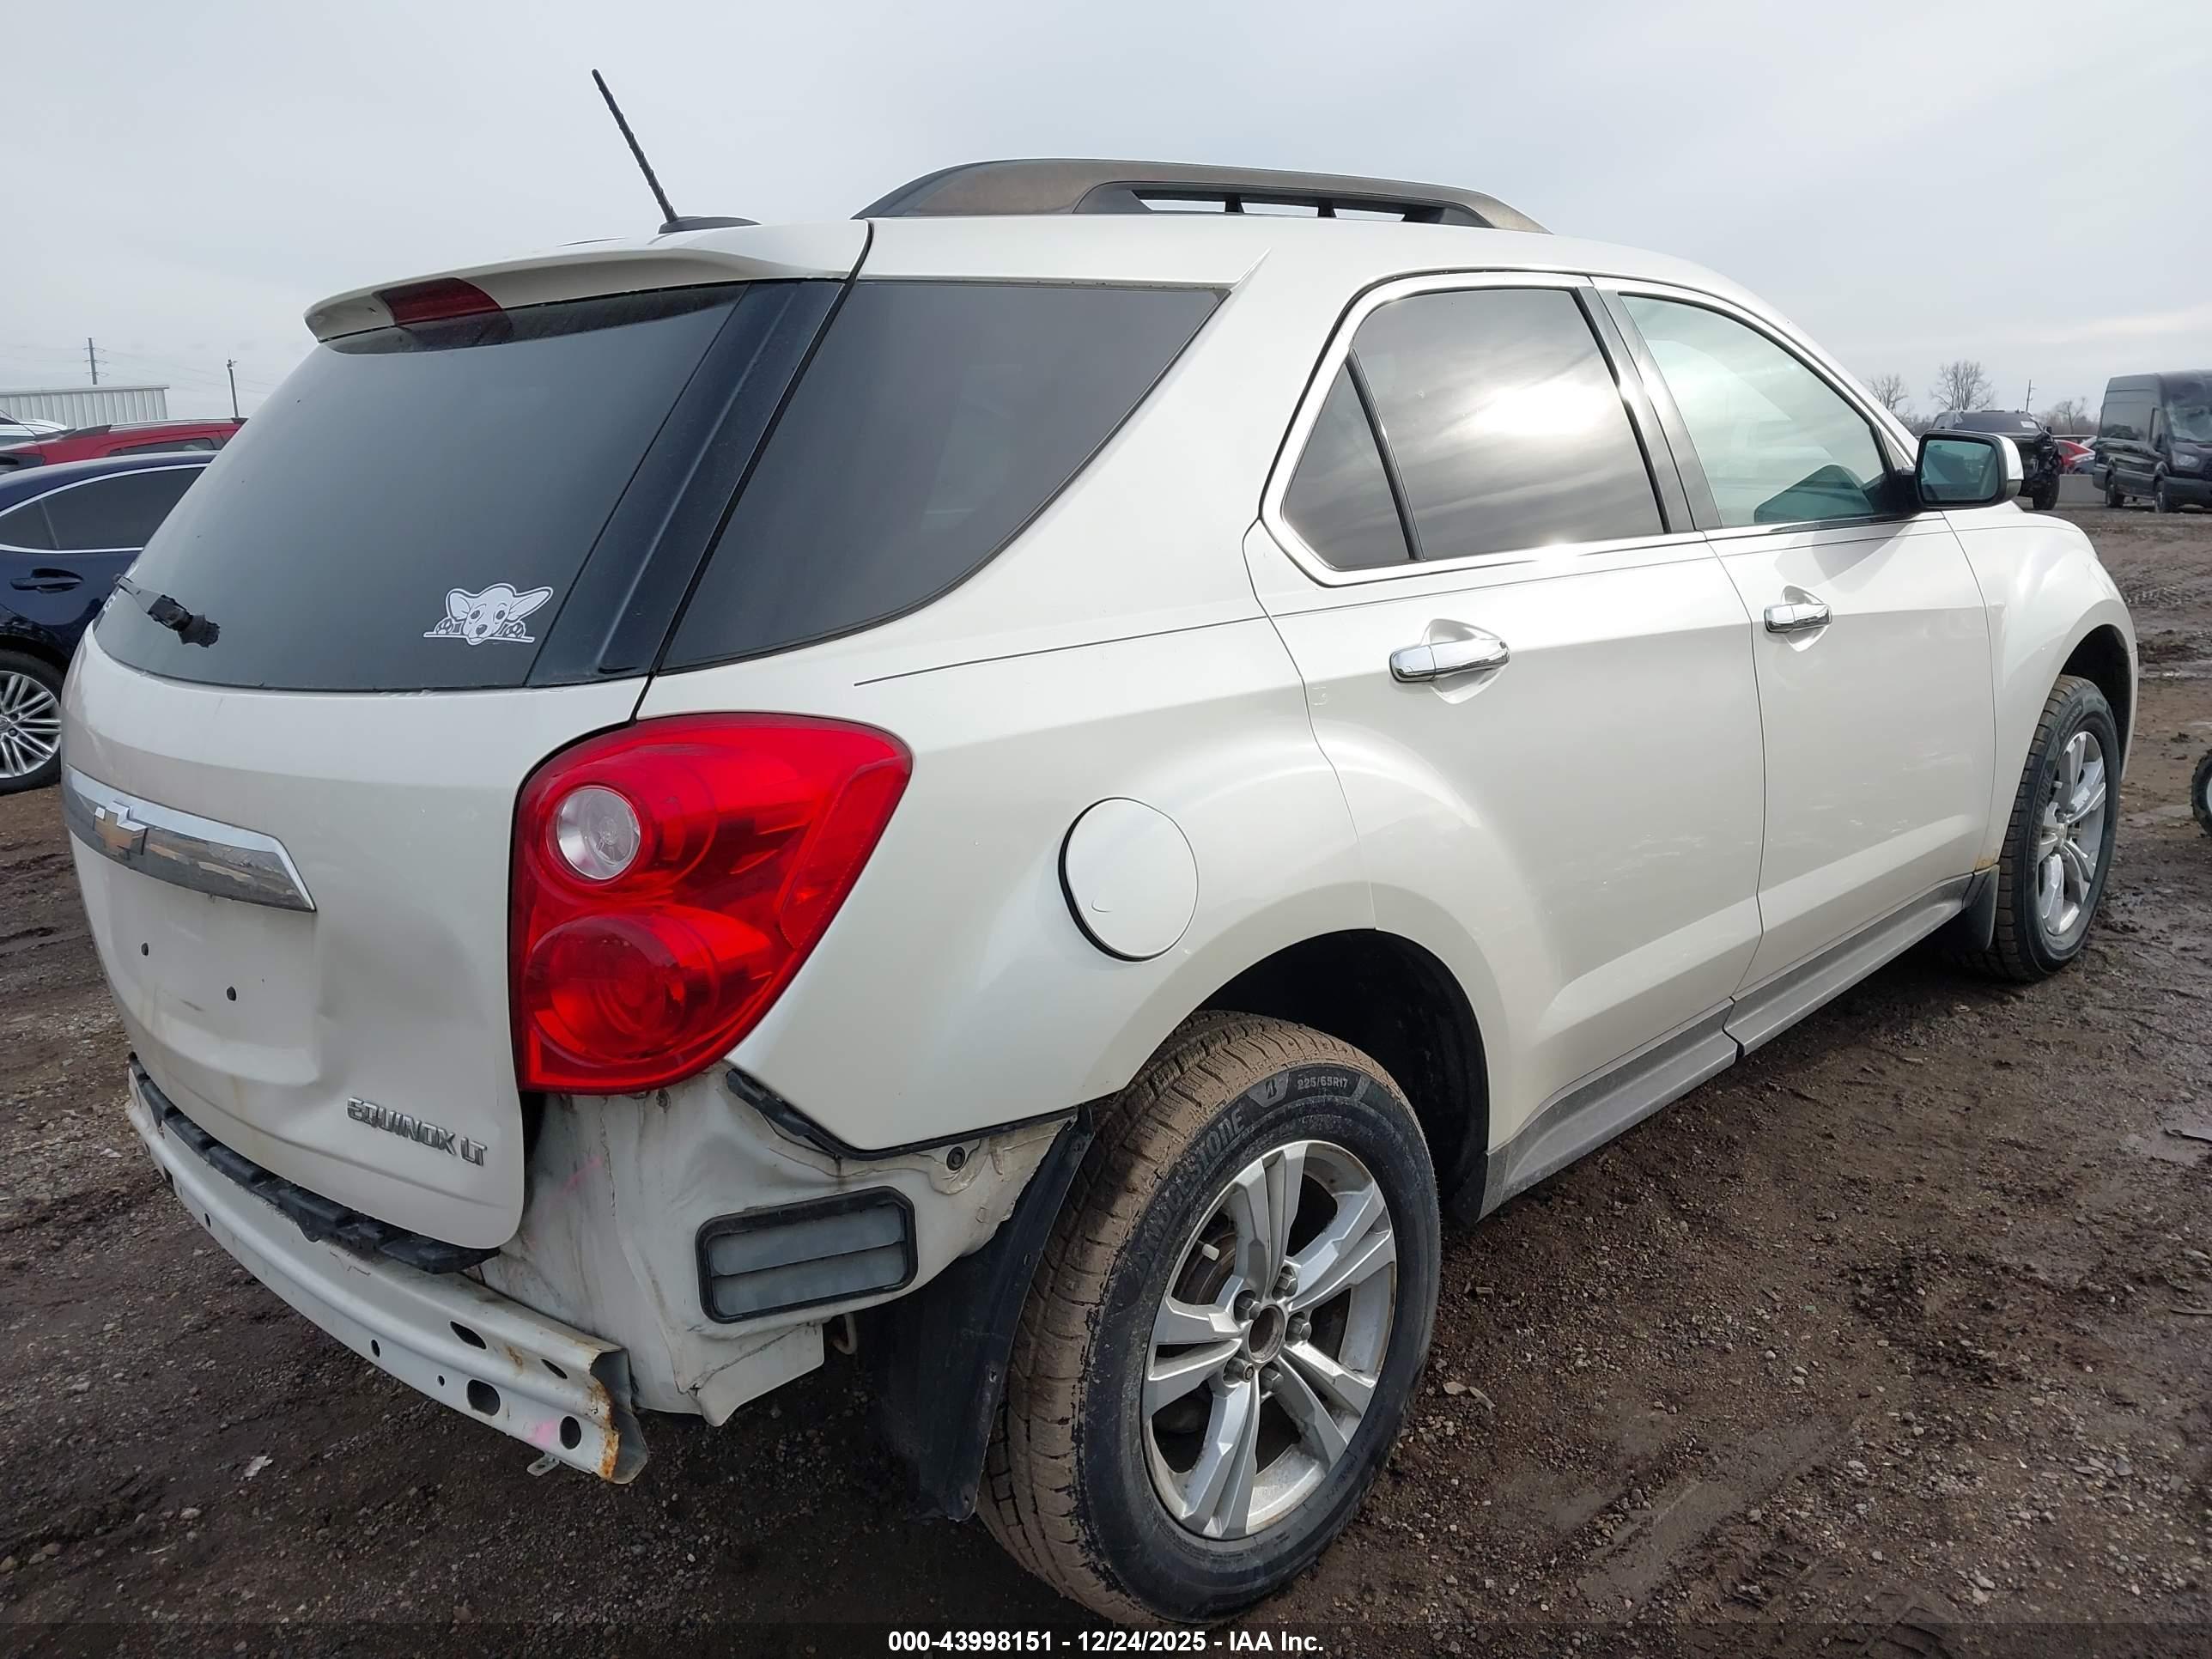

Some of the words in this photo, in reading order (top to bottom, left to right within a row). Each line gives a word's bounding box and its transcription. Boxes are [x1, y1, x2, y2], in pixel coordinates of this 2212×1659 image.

[1297, 1076, 1348, 1091] 225/65R17
[347, 1097, 457, 1156] EQUINOX
[460, 1137, 488, 1166] LT
